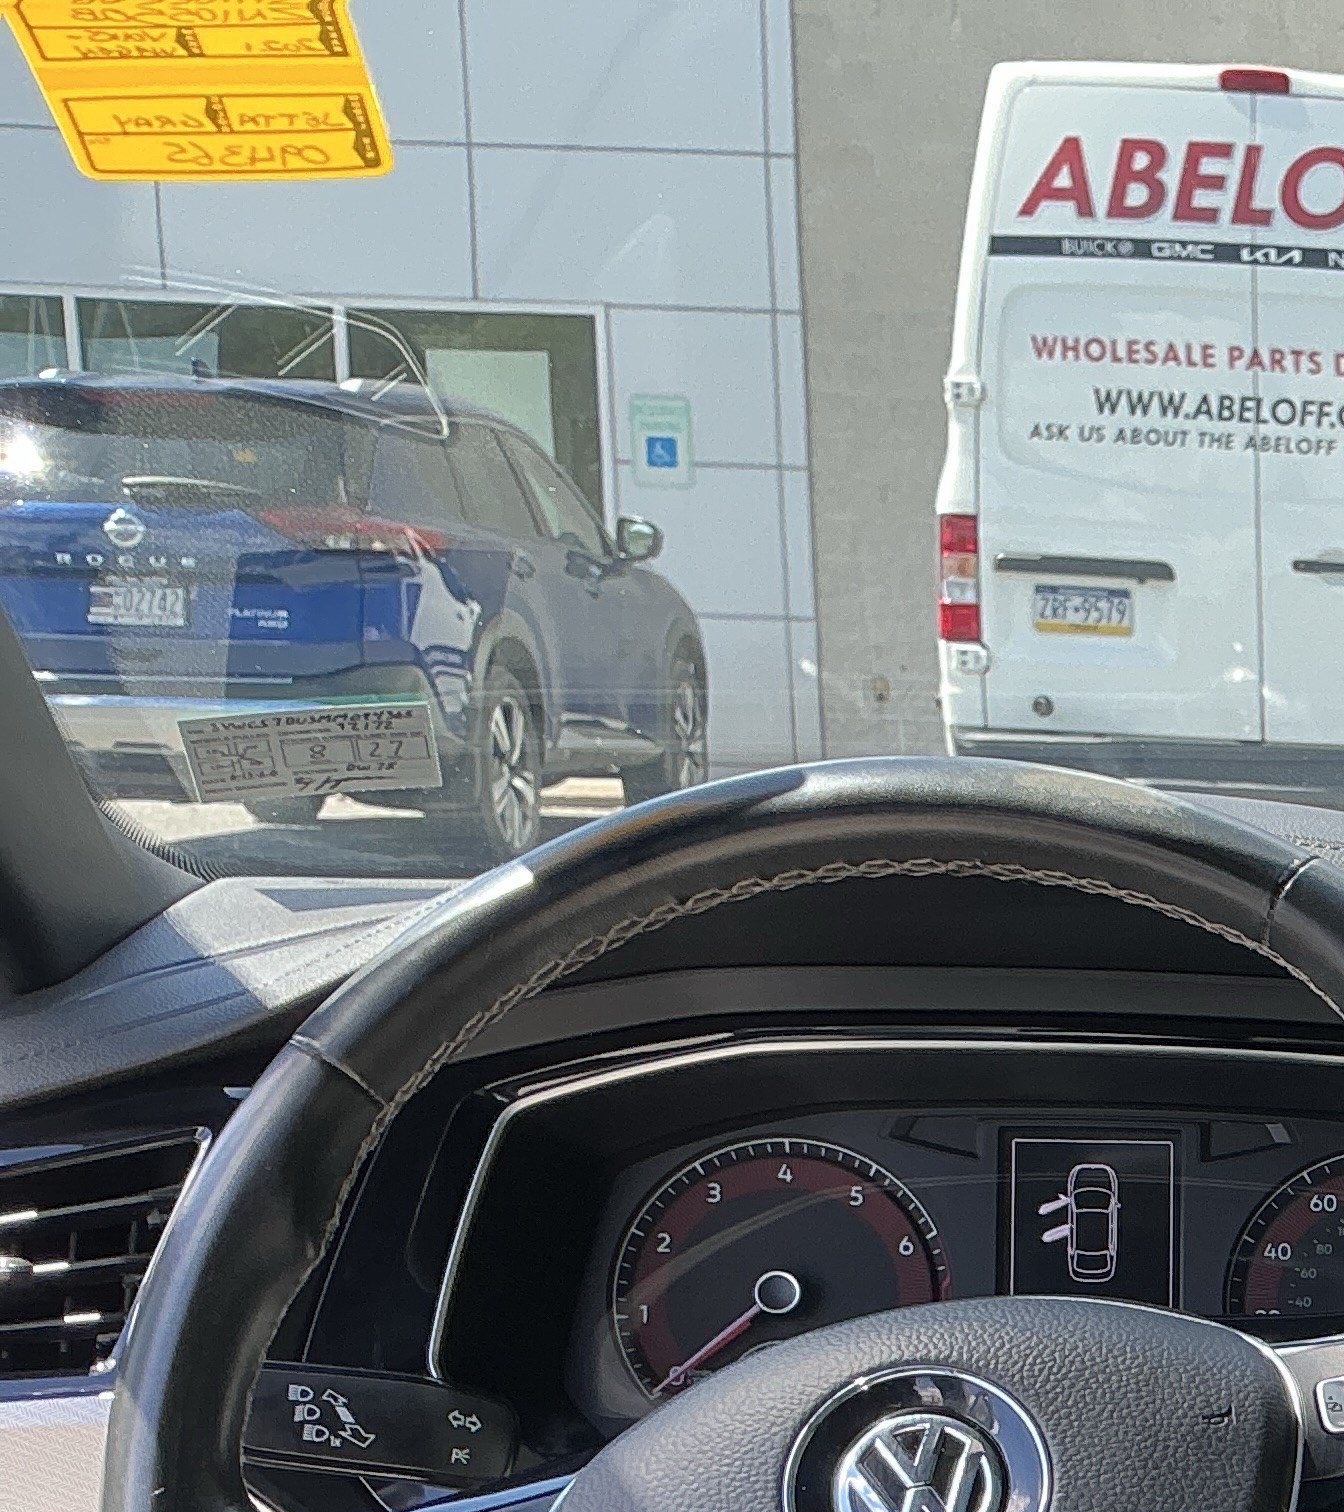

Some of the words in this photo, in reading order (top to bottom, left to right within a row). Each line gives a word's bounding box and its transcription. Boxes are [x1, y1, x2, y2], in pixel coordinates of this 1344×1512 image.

[1061, 237, 1117, 255] BUICK
[1150, 241, 1215, 260] GMC
[1030, 334, 1217, 368] WHOLESALE
[1227, 345, 1323, 375] PARTS
[1028, 422, 1070, 441] ASK
[1077, 424, 1106, 443] US
[1113, 427, 1190, 447] ABOUT
[1197, 431, 1235, 450] THE
[1244, 434, 1338, 456] ABELOFF
[777, 1163, 793, 1184] 4
[705, 1182, 722, 1204] 3
[849, 1185, 864, 1207] 5
[1309, 1194, 1337, 1213] 60
[656, 1232, 672, 1254] 2
[898, 1235, 914, 1256] 6
[1263, 1242, 1291, 1261] 40
[1316, 1244, 1333, 1255] 80
[1300, 1268, 1317, 1279] 60
[1294, 1296, 1312, 1308] 40
[638, 1304, 649, 1325] 1
